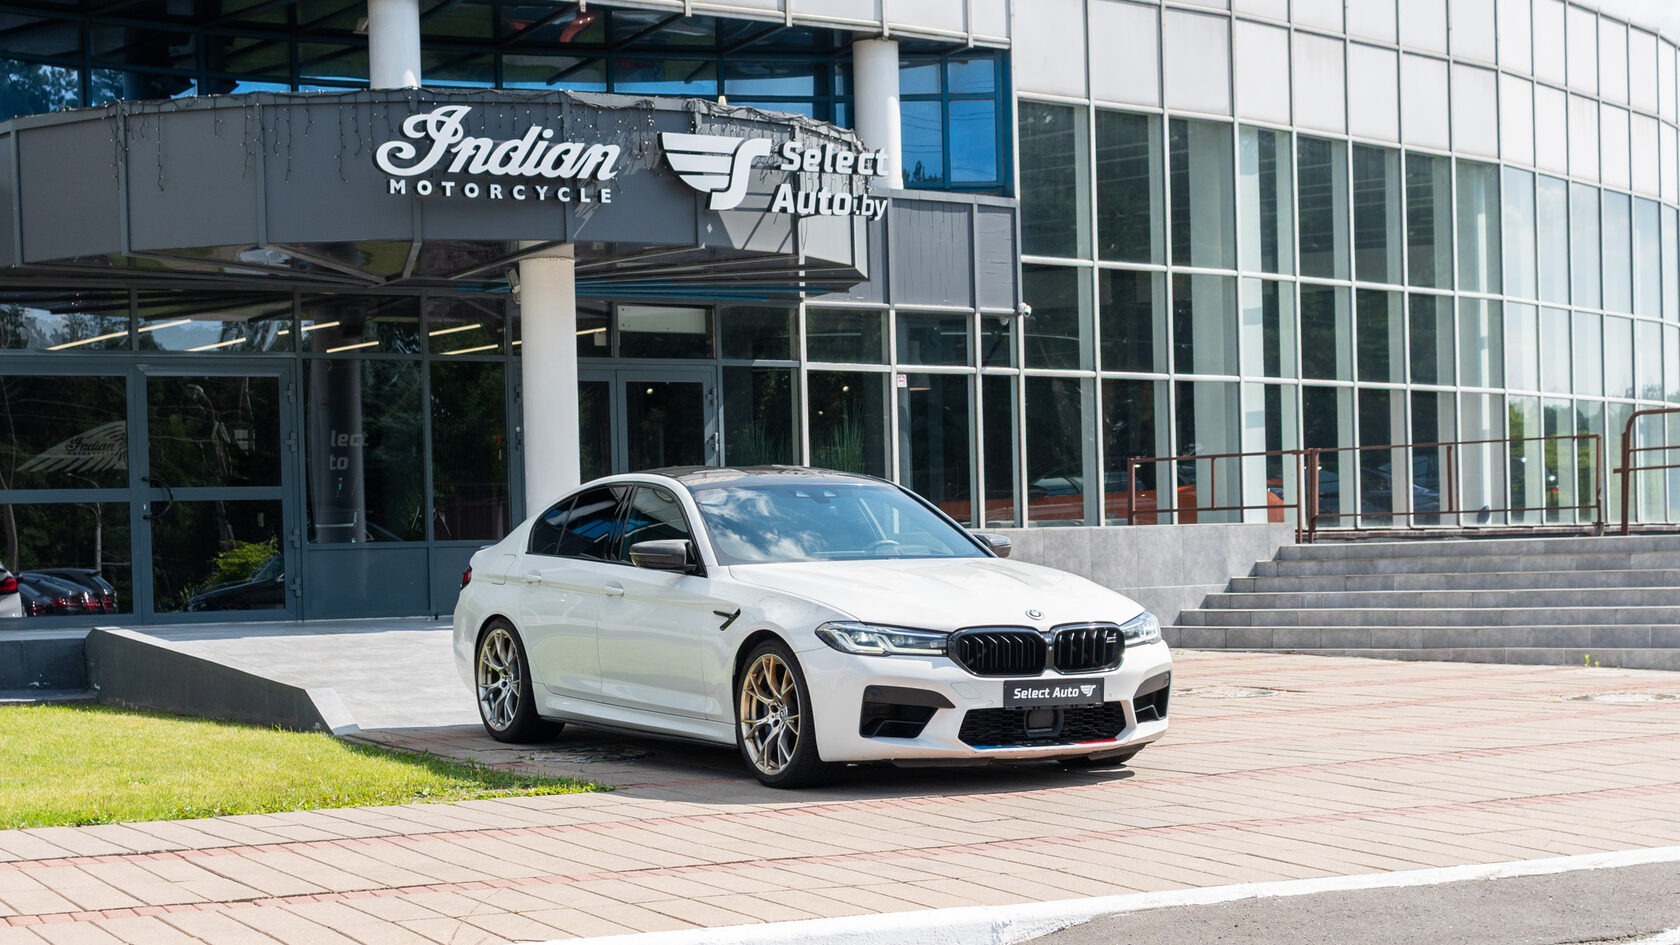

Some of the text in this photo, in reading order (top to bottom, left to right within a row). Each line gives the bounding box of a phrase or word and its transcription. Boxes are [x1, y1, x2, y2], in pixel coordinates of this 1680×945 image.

[376, 105, 621, 181] Indian
[780, 141, 889, 176] Select
[390, 178, 612, 204] MOTORCYCLE
[1013, 686, 1079, 699] Select Auto
